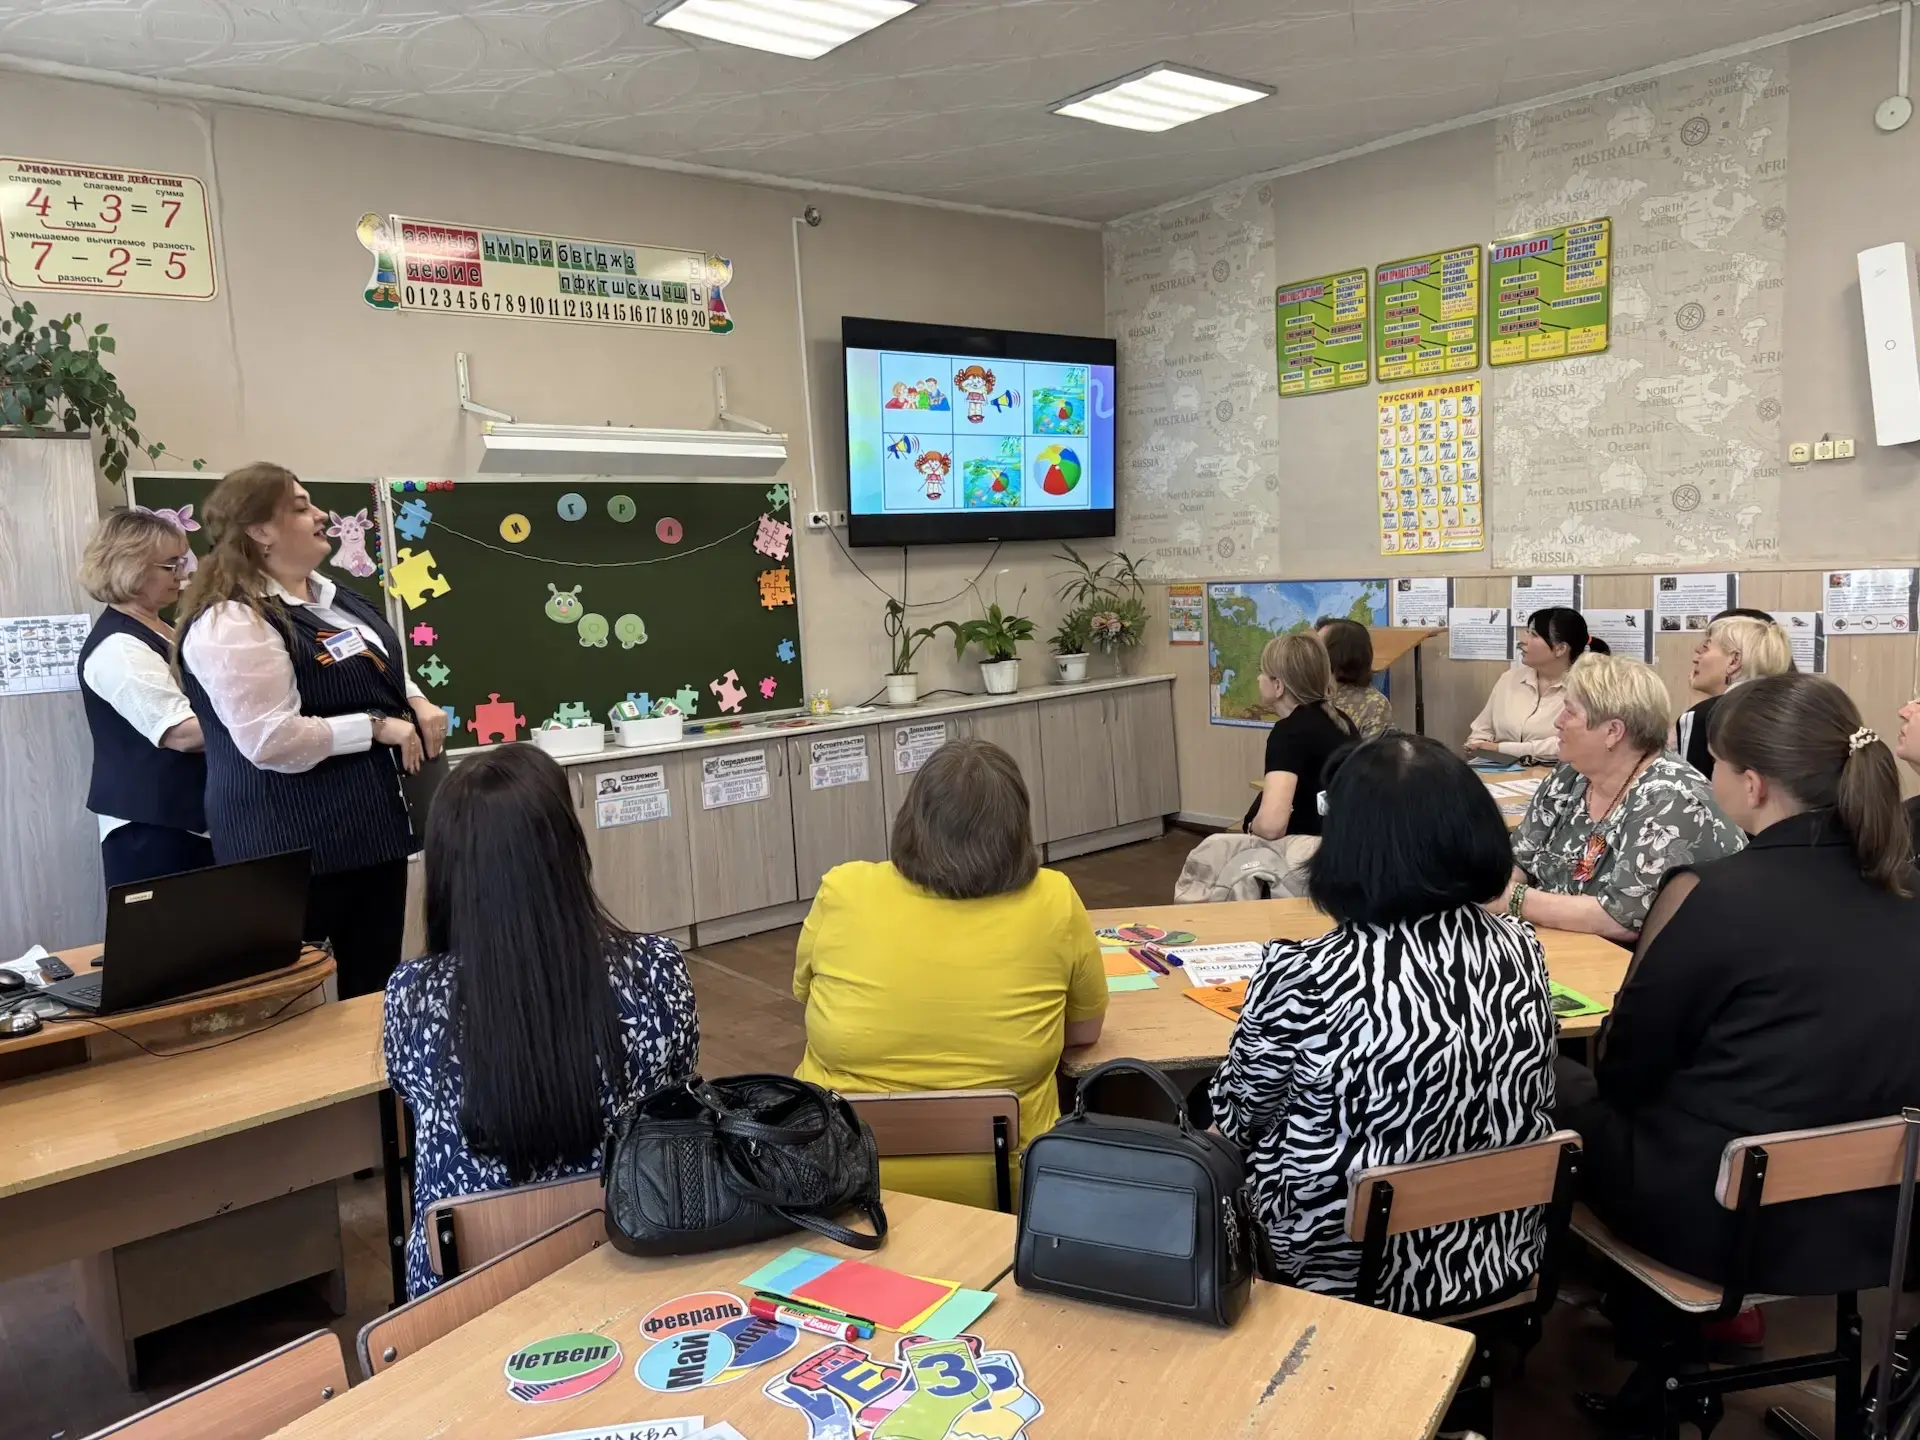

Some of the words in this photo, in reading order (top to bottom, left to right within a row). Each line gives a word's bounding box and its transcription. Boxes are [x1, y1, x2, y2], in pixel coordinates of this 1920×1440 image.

[1614, 80, 1660, 98] Ocean
[1571, 141, 1650, 170] AUSTRALIA
[17, 164, 124, 182] АРИФМЕТИЧЕСКИЕ
[127, 174, 183, 188] ДЕЙСТВИЯ
[9, 175, 62, 187] слагаемое
[83, 181, 133, 193] слагаемое
[155, 188, 185, 198] сумма
[1566, 191, 1590, 202] ASIA
[26, 187, 52, 217] 4
[67, 195, 84, 211] +
[99, 194, 122, 223] 3
[131, 203, 147, 213] =
[161, 200, 181, 228] 7
[1650, 202, 1684, 215] NORTH
[65, 219, 97, 229] сумма
[1534, 210, 1579, 229] RUSSIA
[1568, 227, 1587, 235] ЧАСТЬ
[10, 230, 80, 243] уменьшаемое
[87, 236, 146, 248] вычитаемое
[152, 241, 196, 252] разность
[1495, 239, 1549, 260] ГЛАГОЛ
[1632, 239, 1679, 258] Pacific
[30, 241, 53, 271] 7
[106, 247, 131, 277] 2
[135, 257, 152, 267] =
[164, 251, 187, 280] 5
[1443, 252, 1459, 260] ЧАСТЬ
[1612, 263, 1654, 279] Ocean
[57, 273, 104, 284] разность
[1150, 276, 1197, 293] AUSTRALIA
[1512, 288, 1536, 299] ЧИСЛАМ
[406, 286, 415, 304] 0
[420, 287, 426, 305] 1
[430, 288, 439, 306] 2
[443, 289, 451, 307] 3
[456, 290, 465, 308] 4
[469, 291, 477, 310] 5
[482, 292, 490, 311] 6
[494, 293, 501, 311] 7
[506, 294, 514, 313] 8
[518, 295, 526, 313] 9
[530, 296, 544, 315] 10
[548, 298, 560, 316] 11
[564, 299, 576, 317] 12
[580, 300, 593, 318] 13
[596, 302, 609, 320] 14
[613, 303, 626, 321] 15
[629, 304, 642, 322] 16
[646, 306, 656, 323] 17
[661, 307, 673, 324] 18
[676, 308, 688, 326] 19
[692, 310, 705, 327] 20
[1552, 294, 1601, 308] МНОЖЕСТВЕННОЕ
[1499, 305, 1540, 317] ЕДИНСТВЕННОЕ
[1128, 325, 1156, 338] RUSSIA
[1509, 320, 1538, 331] ВРЕМЕНАМ
[1562, 365, 1586, 376] ASIA
[1384, 389, 1424, 403] РУССКИЙ
[1427, 384, 1474, 396] АЛФАВИТ
[1531, 384, 1576, 399] RUSSIA
[1646, 384, 1679, 396] NORTH
[1153, 412, 1200, 428] AUSTRALIA
[1587, 424, 1626, 438] North
[1628, 420, 1673, 435] Pacific
[1607, 442, 1650, 453] Ocean
[1167, 491, 1190, 500] North
[1557, 485, 1588, 496] Ocean
[1179, 502, 1204, 512] Ocean
[1567, 498, 1643, 513] AUSTRALIA
[1560, 535, 1585, 545] ASIA
[1156, 546, 1201, 557] AUSTRALIA
[1531, 552, 1575, 563] RUSSIA
[814, 738, 864, 750] Обстоятельство
[721, 755, 763, 766] Определение
[621, 771, 658, 782] Сказуемое
[620, 805, 643, 813] падеж
[620, 812, 643, 821] кому?
[643, 1303, 743, 1333] Февраль
[808, 1317, 841, 1333] Board
[508, 1343, 613, 1370] Четверг
[666, 1333, 711, 1389] Май
